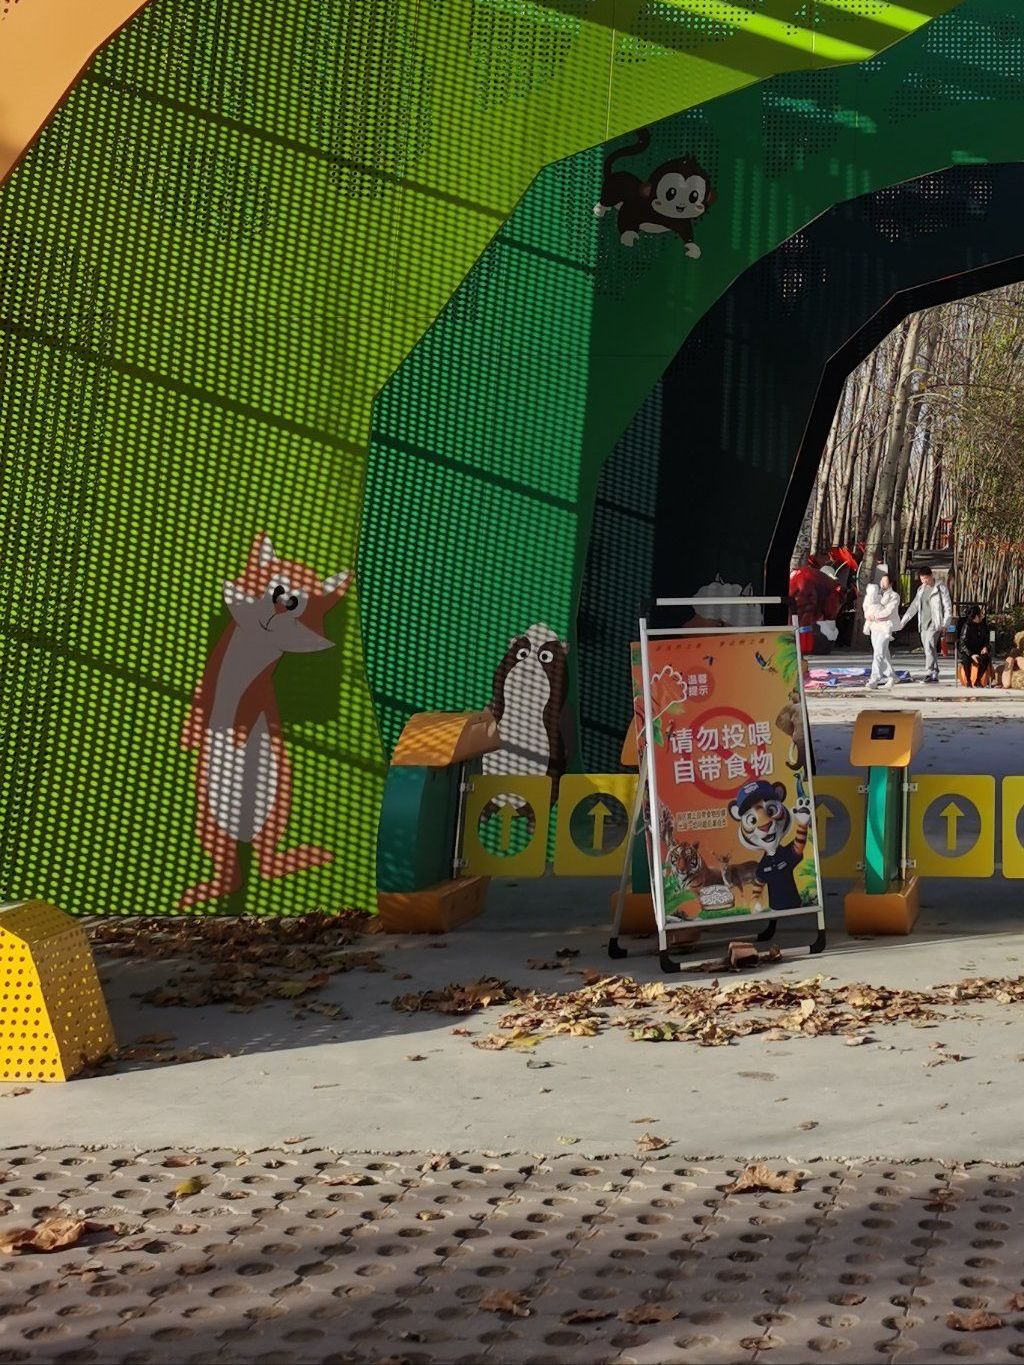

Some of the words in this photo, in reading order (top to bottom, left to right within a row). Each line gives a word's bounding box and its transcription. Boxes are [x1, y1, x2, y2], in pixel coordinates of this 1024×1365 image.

[669, 720, 773, 755] 请勿投喂
[673, 750, 775, 785] 自带食物
